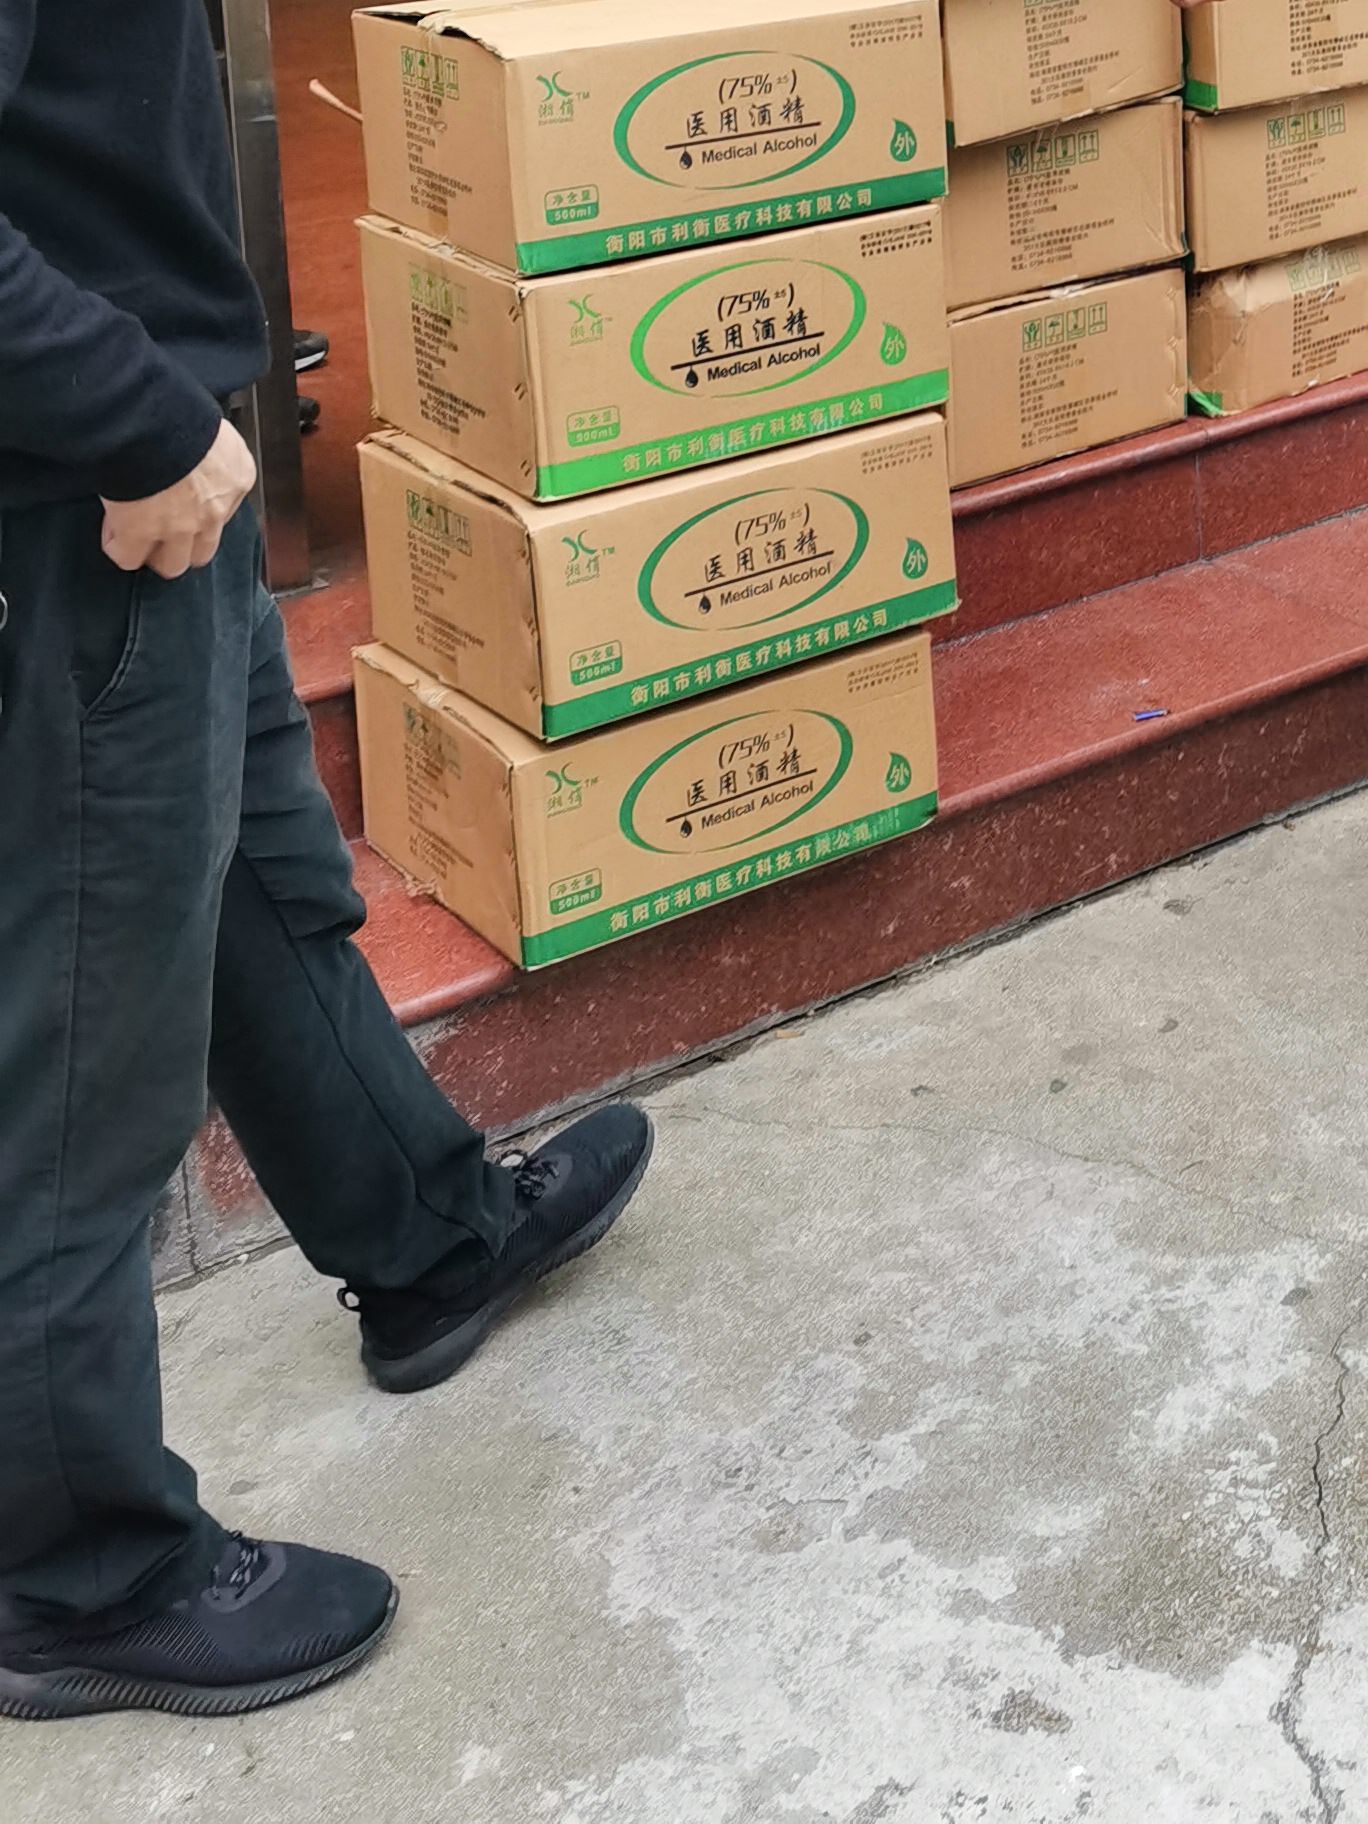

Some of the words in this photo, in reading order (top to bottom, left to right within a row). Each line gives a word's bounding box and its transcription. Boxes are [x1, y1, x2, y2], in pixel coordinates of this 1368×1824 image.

[686, 95, 807, 137] 医用酒精
[701, 142, 758, 165] Medical
[763, 133, 818, 156] Alcohol
[605, 187, 874, 254] 衡阳市利衡医疗科技有限公司
[691, 308, 809, 357] 医用酒精
[707, 358, 763, 382] Medical
[767, 342, 821, 368] Alcohol
[622, 392, 884, 473] 衡阳市利衡医疗科技有限公司
[704, 527, 820, 583] 医用酒精
[720, 580, 774, 607] Medical
[778, 561, 833, 592] Alcohol
[630, 606, 889, 707] 衡阳市利衡医疗科技有限公司
[686, 747, 803, 807] 医用酒精
[701, 801, 756, 831] Medical
[759, 781, 814, 813] Alcohol
[609, 821, 873, 932] 衡阳市利衡医疗科技有限公司
